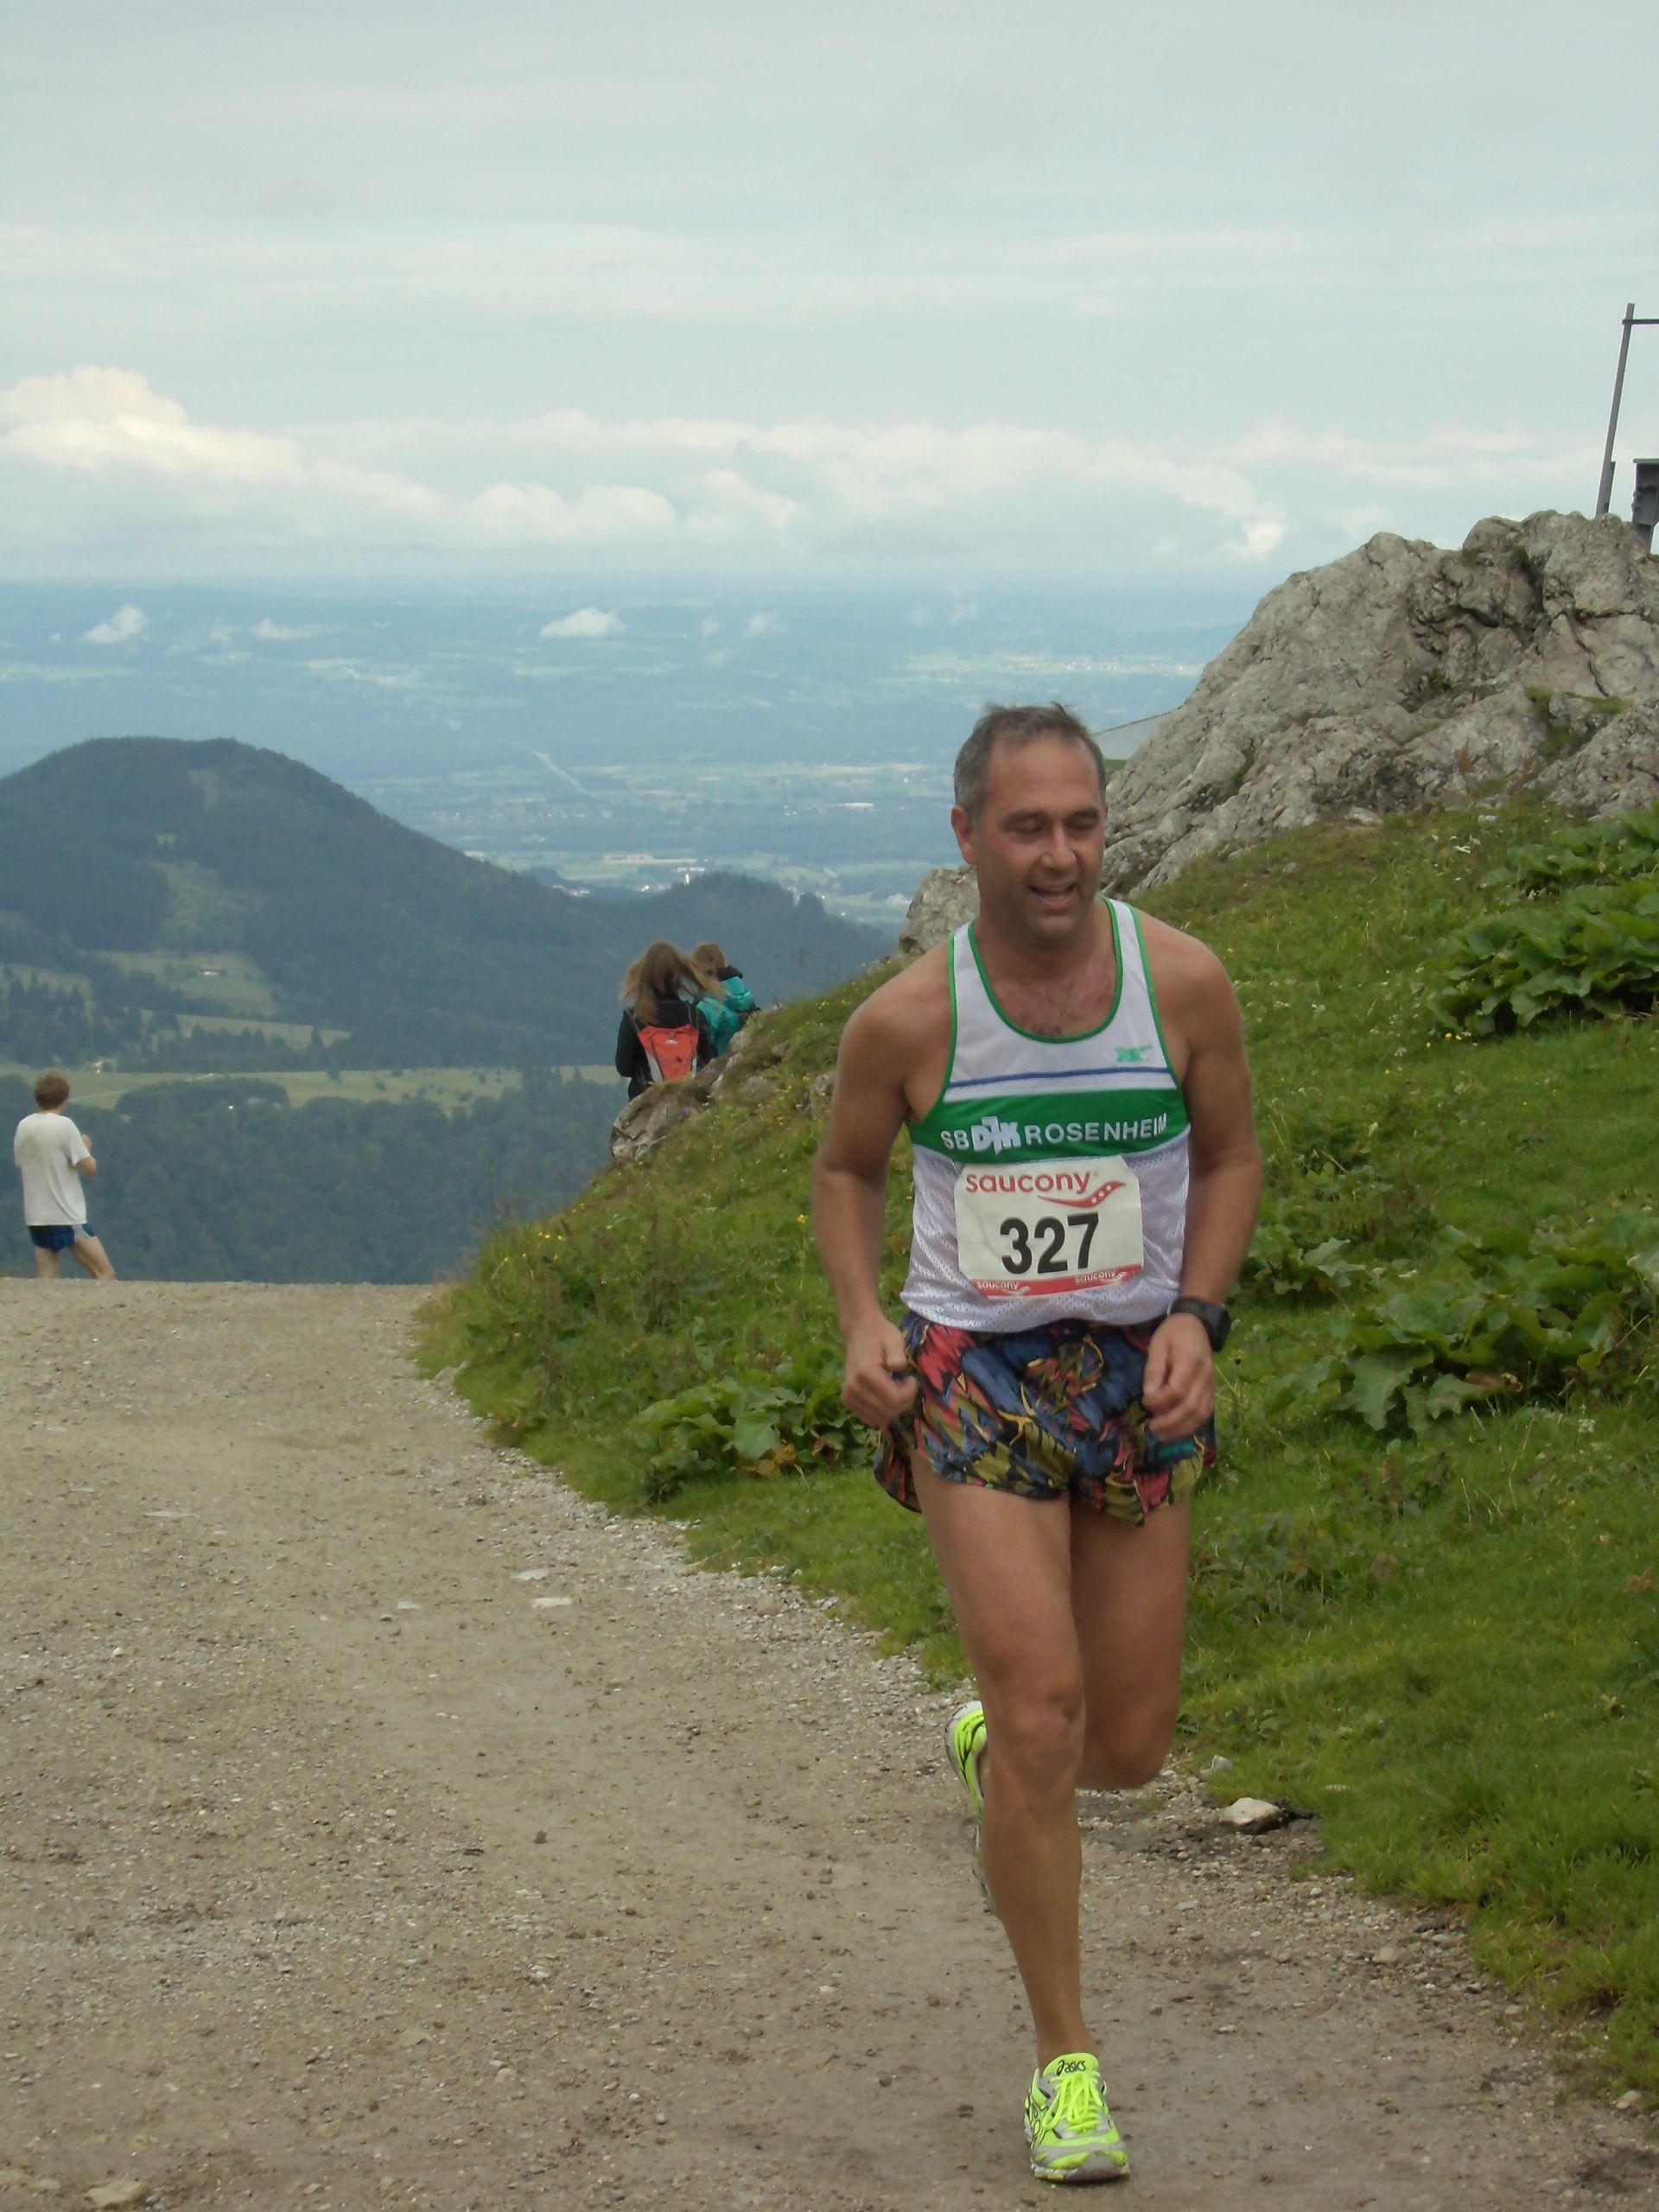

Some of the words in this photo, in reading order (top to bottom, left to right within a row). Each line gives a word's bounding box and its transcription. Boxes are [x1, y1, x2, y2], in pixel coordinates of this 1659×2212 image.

[1025, 1113, 1167, 1145] ROSENHEIM
[965, 1171, 1091, 1195] saucony
[1000, 1212, 1099, 1274] 327
